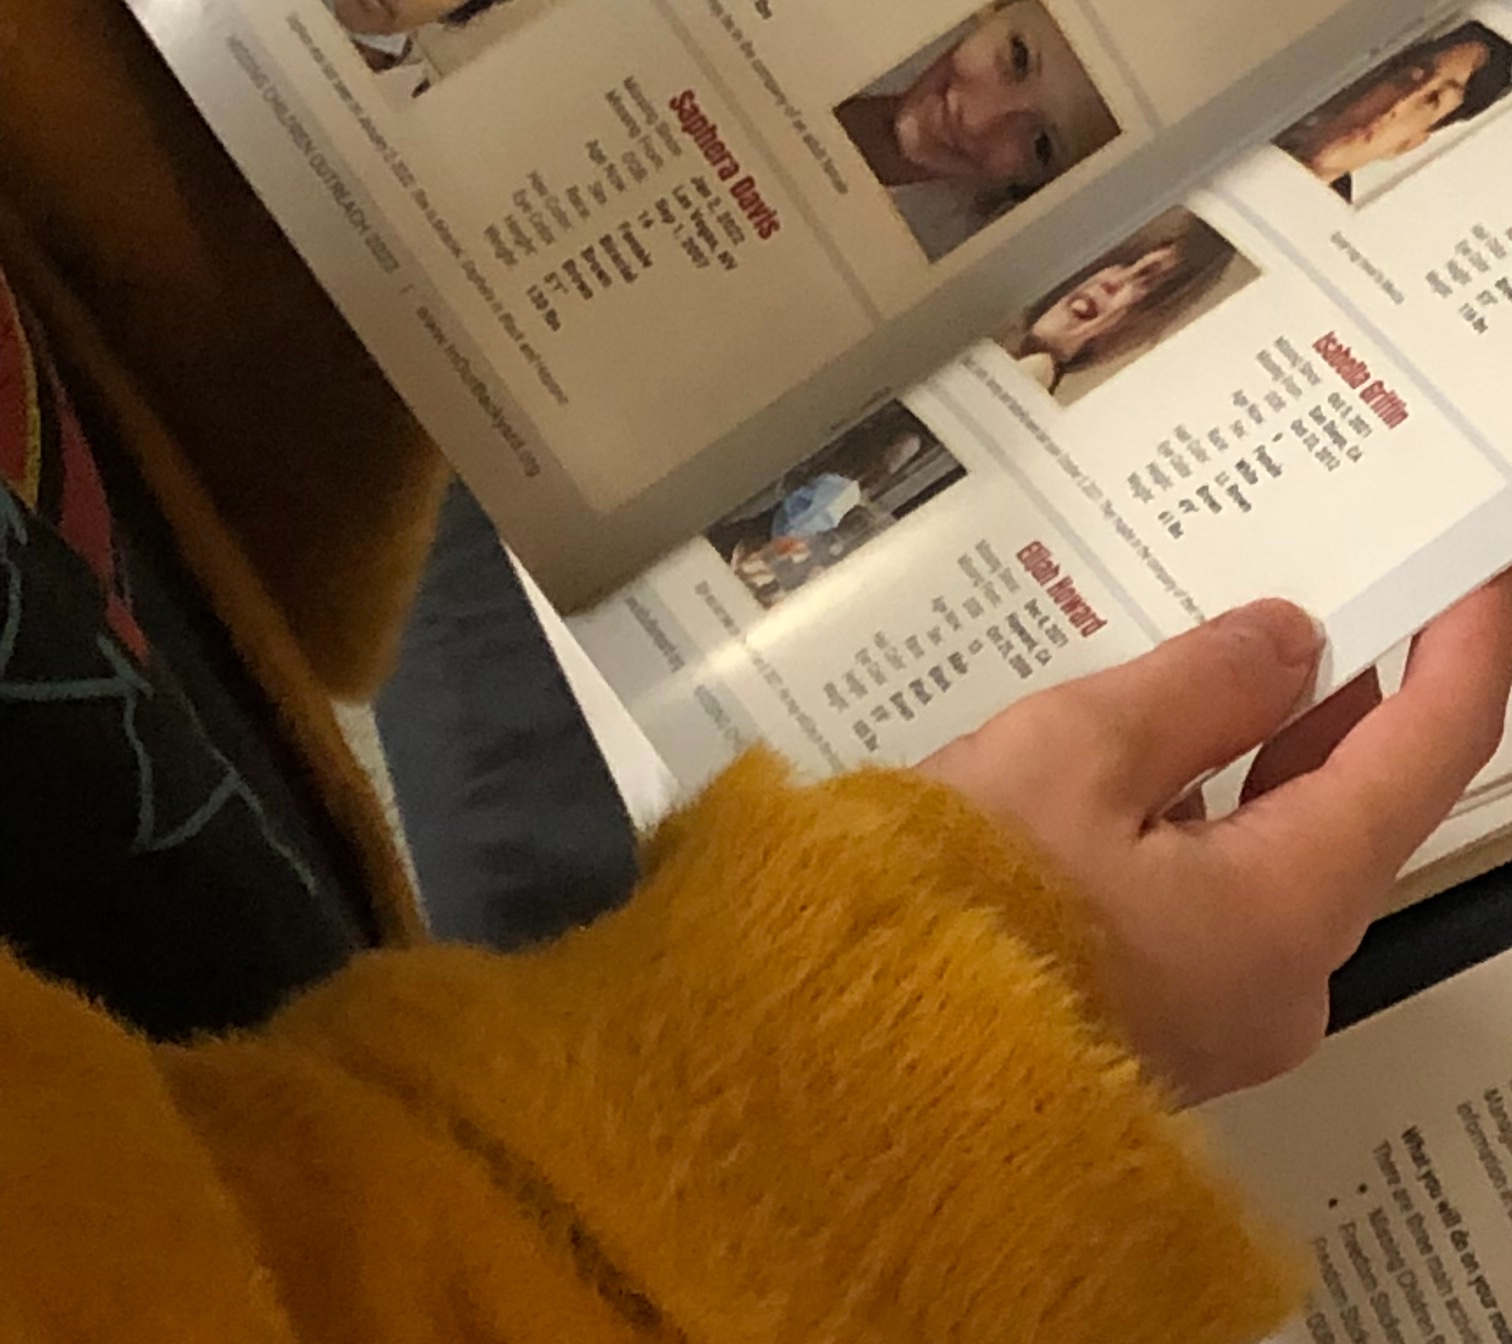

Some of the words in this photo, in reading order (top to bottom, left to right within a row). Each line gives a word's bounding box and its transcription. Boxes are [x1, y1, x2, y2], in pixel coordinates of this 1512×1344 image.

[666, 88, 742, 182] Saphera
[726, 173, 787, 241] Davis
[1311, 330, 1371, 388] Isabella
[1014, 540, 1059, 586] Elijah
[1045, 575, 1108, 637] Howard
[1401, 1126, 1432, 1169] What
[1417, 1169, 1442, 1201] you
[1434, 1198, 1460, 1229] will
[1448, 1227, 1471, 1252] do
[1459, 1252, 1478, 1274] on
[1466, 1275, 1495, 1313] your
